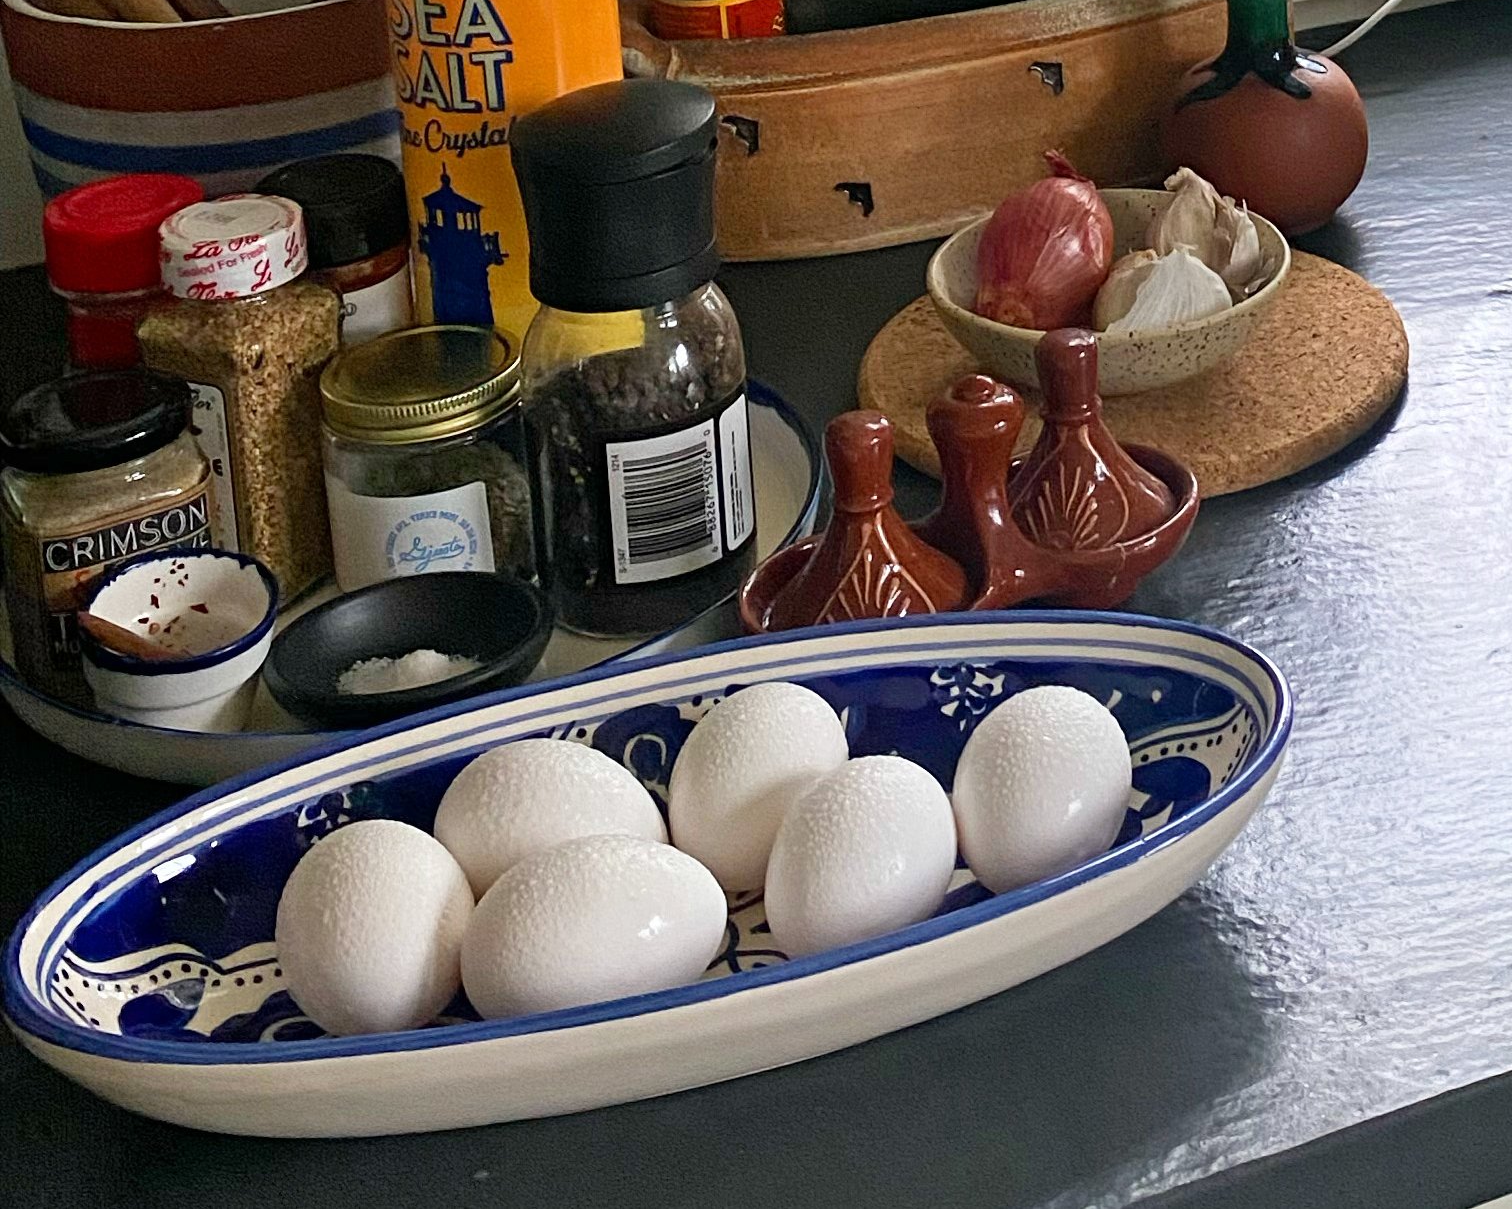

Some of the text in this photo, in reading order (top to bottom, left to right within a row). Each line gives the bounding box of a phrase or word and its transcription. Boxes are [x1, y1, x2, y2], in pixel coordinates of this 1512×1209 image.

[391, 39, 514, 113] SALT
[217, 257, 238, 270] For
[46, 496, 207, 571] CRIMSON
